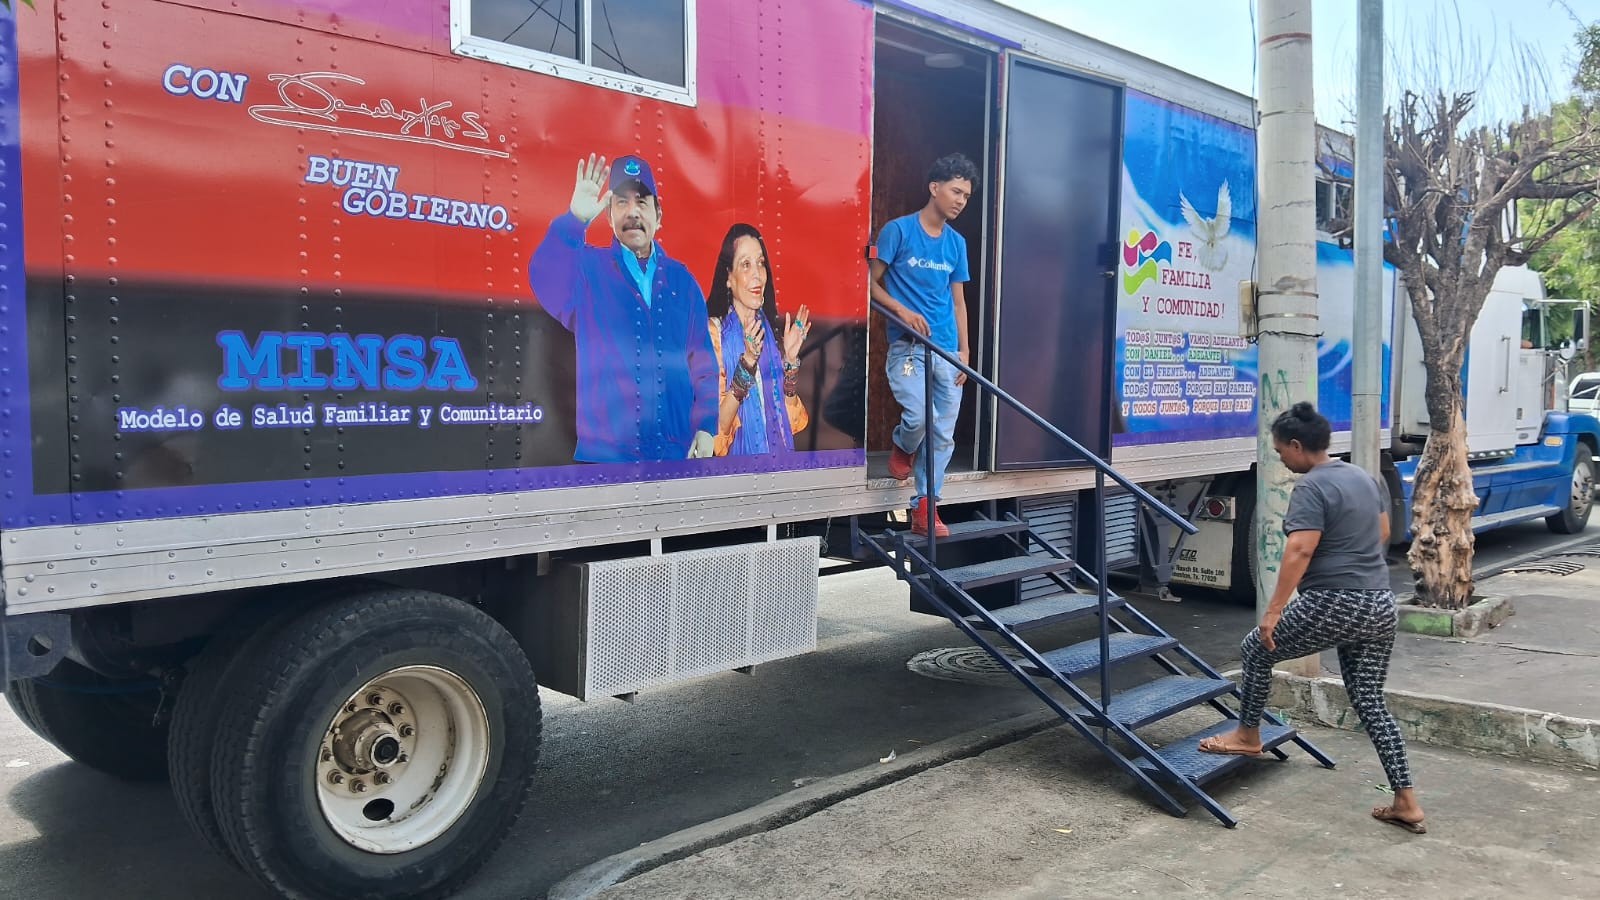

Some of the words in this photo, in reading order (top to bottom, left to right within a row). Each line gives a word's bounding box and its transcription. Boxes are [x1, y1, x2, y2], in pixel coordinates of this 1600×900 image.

[162, 64, 248, 103] CON
[305, 156, 399, 191] BUEN
[342, 188, 515, 231] GOBIERNO.
[1178, 241, 1197, 262] FE,
[1161, 268, 1212, 290] FAMILIA
[1142, 296, 1150, 313] Y
[1156, 297, 1225, 319] COMUNIDAD!
[1189, 333, 1210, 346] VAMOS
[217, 330, 477, 391] MINSA
[1125, 347, 1141, 361] CON
[1124, 365, 1141, 379] CON
[1143, 366, 1154, 379] EL
[1186, 382, 1212, 397] PORQUE
[1214, 383, 1228, 395] HAY
[118, 407, 204, 432] Modelo
[215, 406, 242, 428] de
[253, 405, 316, 427] Salud
[324, 404, 411, 426] Familiar
[419, 408, 432, 427] y
[439, 403, 543, 424] Comunitario
[1122, 402, 1130, 416] Y
[1193, 400, 1219, 415] PORQUE
[1220, 401, 1233, 413] HAY
